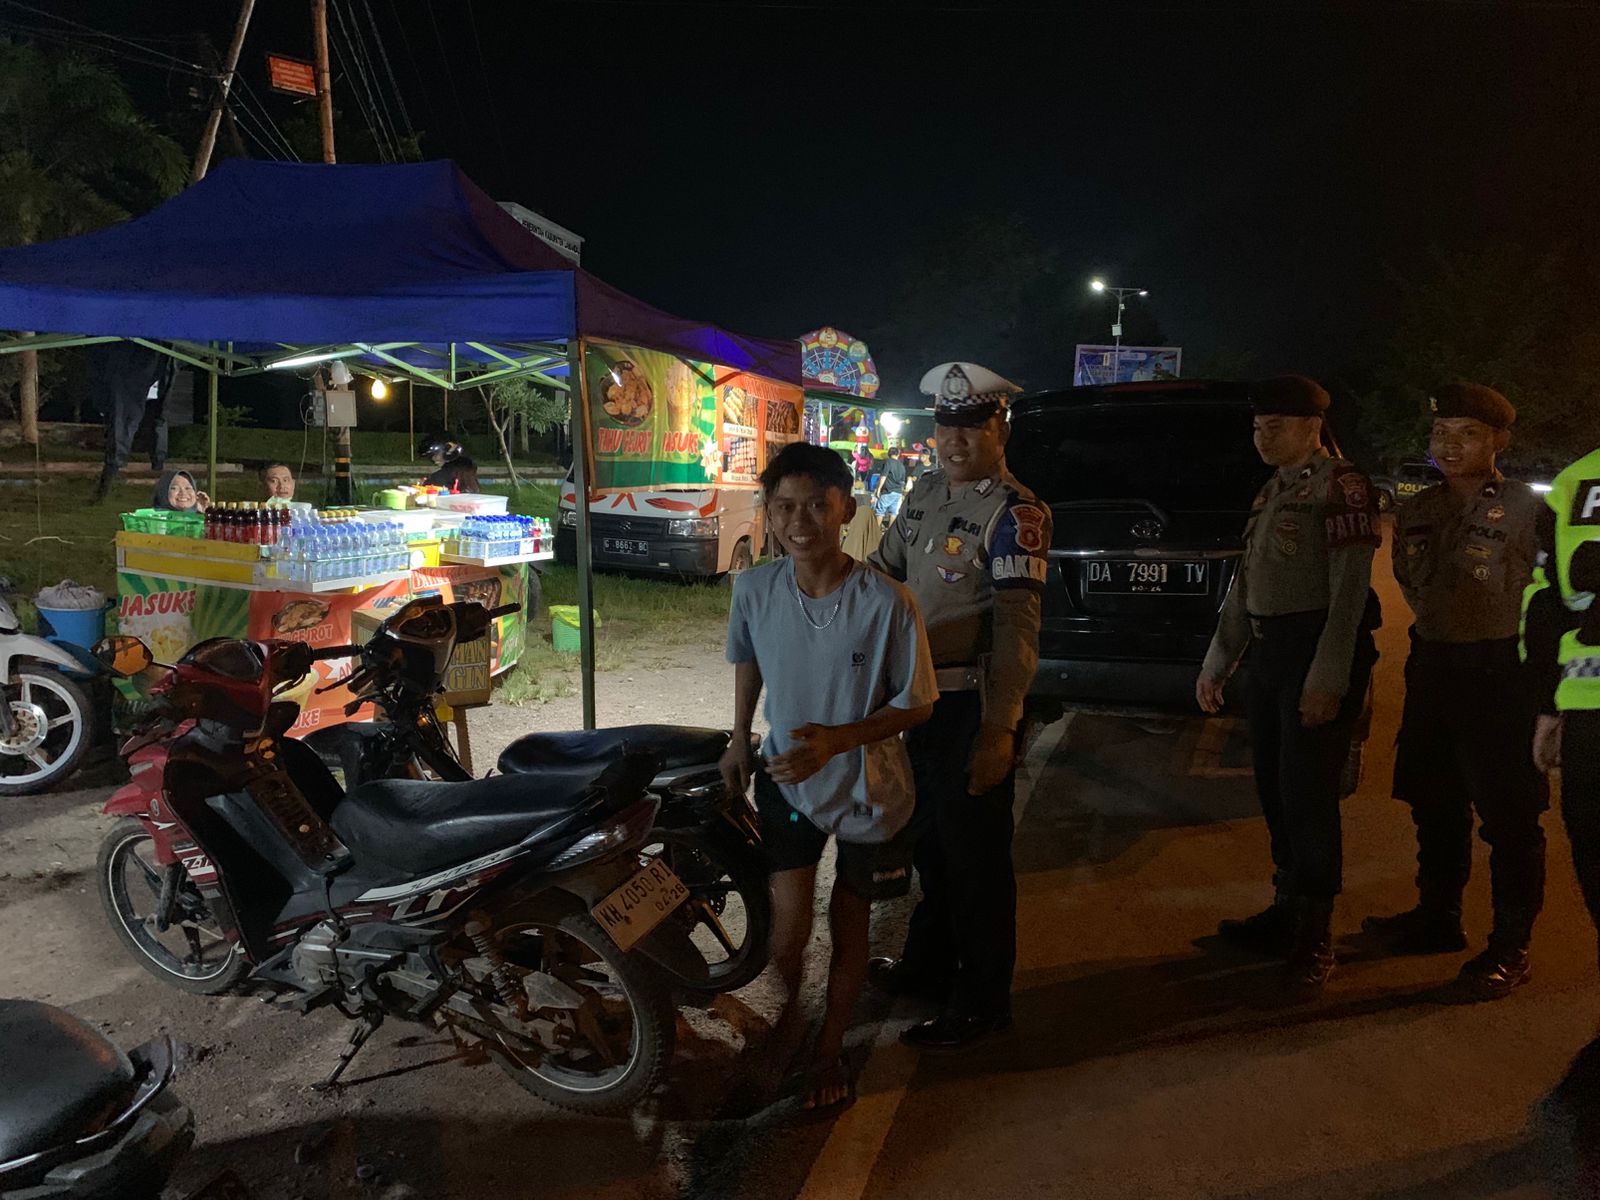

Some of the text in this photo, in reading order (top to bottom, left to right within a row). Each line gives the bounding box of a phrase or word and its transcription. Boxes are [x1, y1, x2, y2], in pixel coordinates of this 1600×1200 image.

[1089, 562, 1112, 582] DA
[1127, 562, 1169, 583] 7991
[620, 876, 655, 911] 4050
